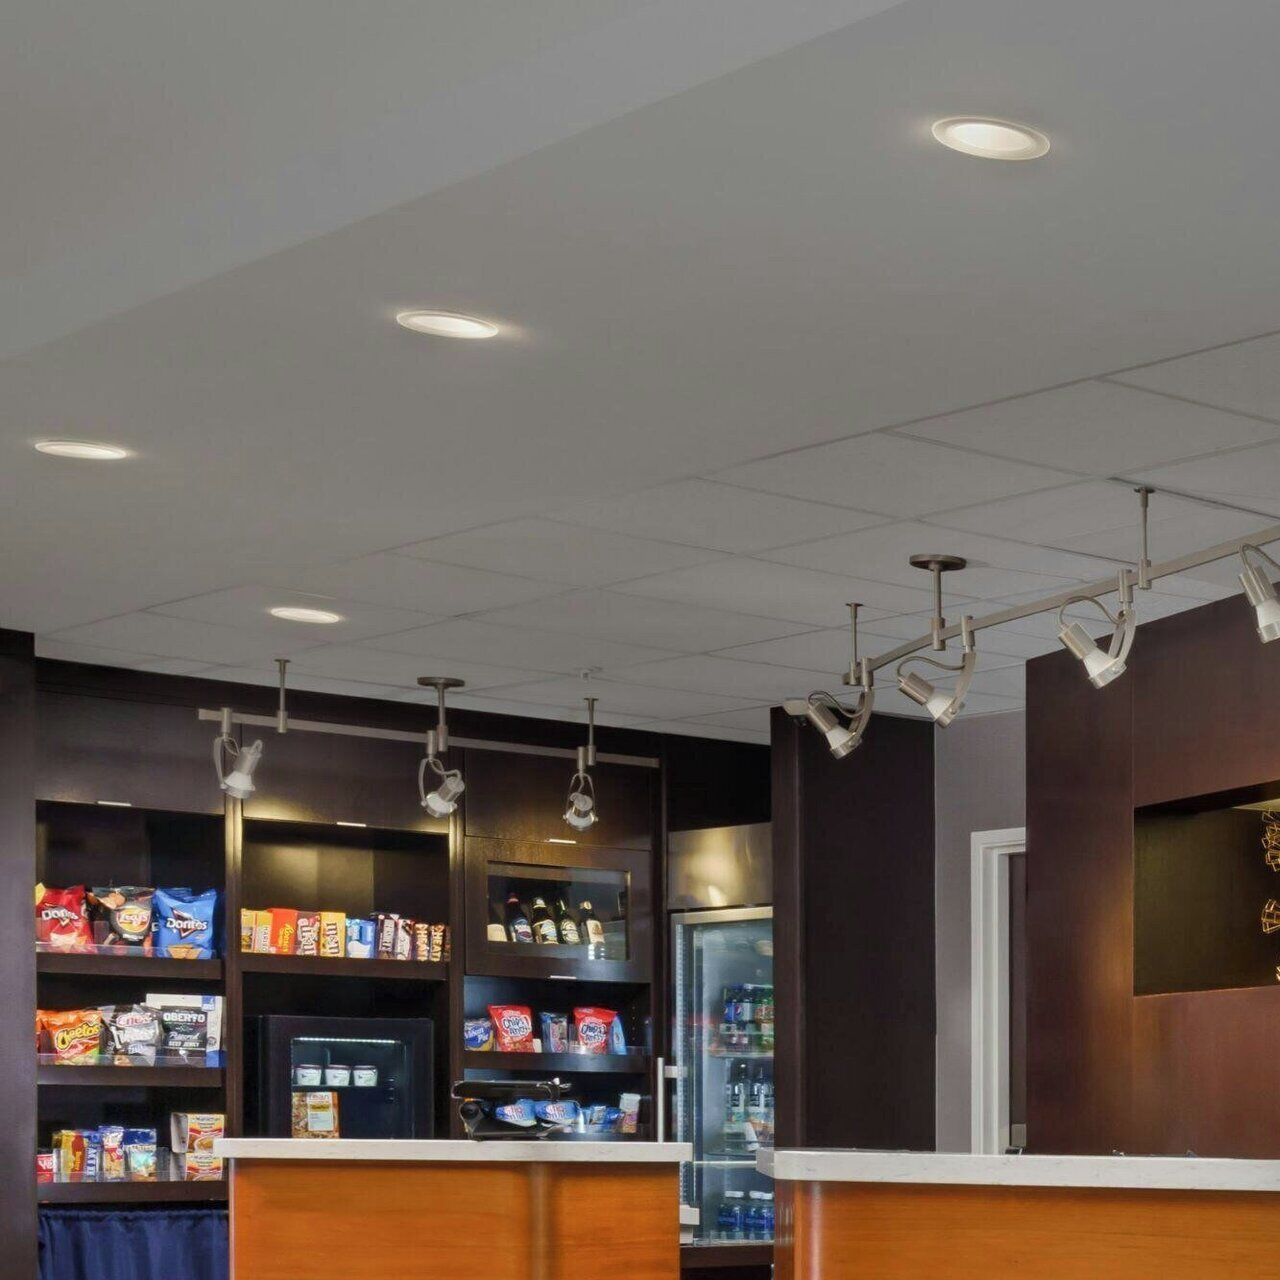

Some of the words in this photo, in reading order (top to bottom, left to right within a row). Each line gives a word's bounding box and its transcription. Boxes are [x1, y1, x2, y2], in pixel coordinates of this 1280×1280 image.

[41, 908, 79, 921] Doritos
[166, 917, 208, 931] Doritos
[163, 1012, 205, 1023] OBERTO
[55, 1021, 100, 1050] Cheetos
